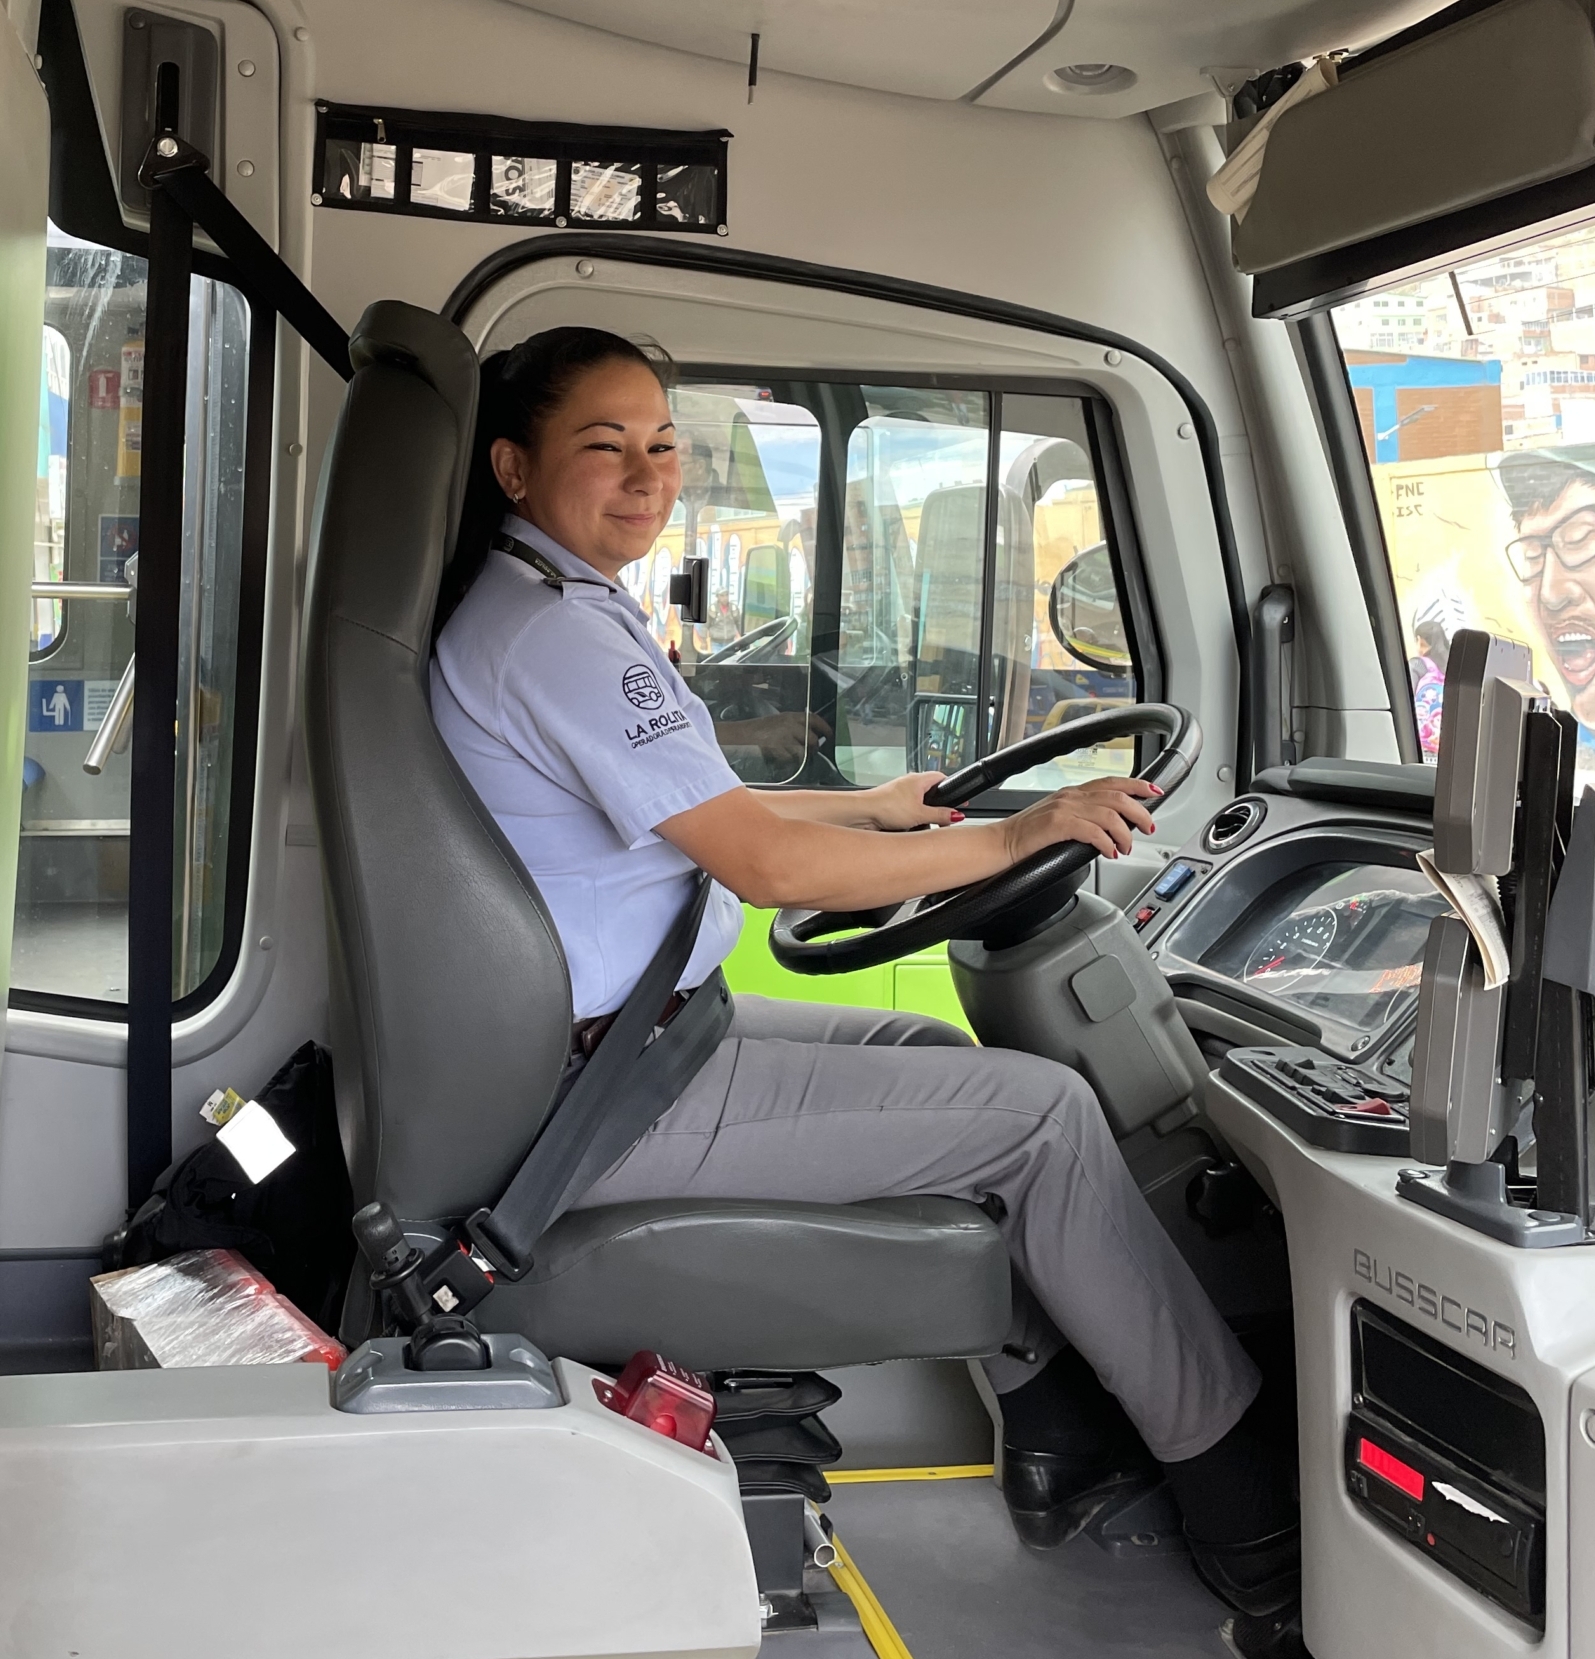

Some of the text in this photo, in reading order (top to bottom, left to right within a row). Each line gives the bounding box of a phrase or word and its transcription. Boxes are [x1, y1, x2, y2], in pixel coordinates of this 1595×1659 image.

[624, 710, 687, 741] LA ROLITA
[631, 730, 665, 749] OPERADORA
[1354, 1248, 1516, 1360] BUSSCAR
